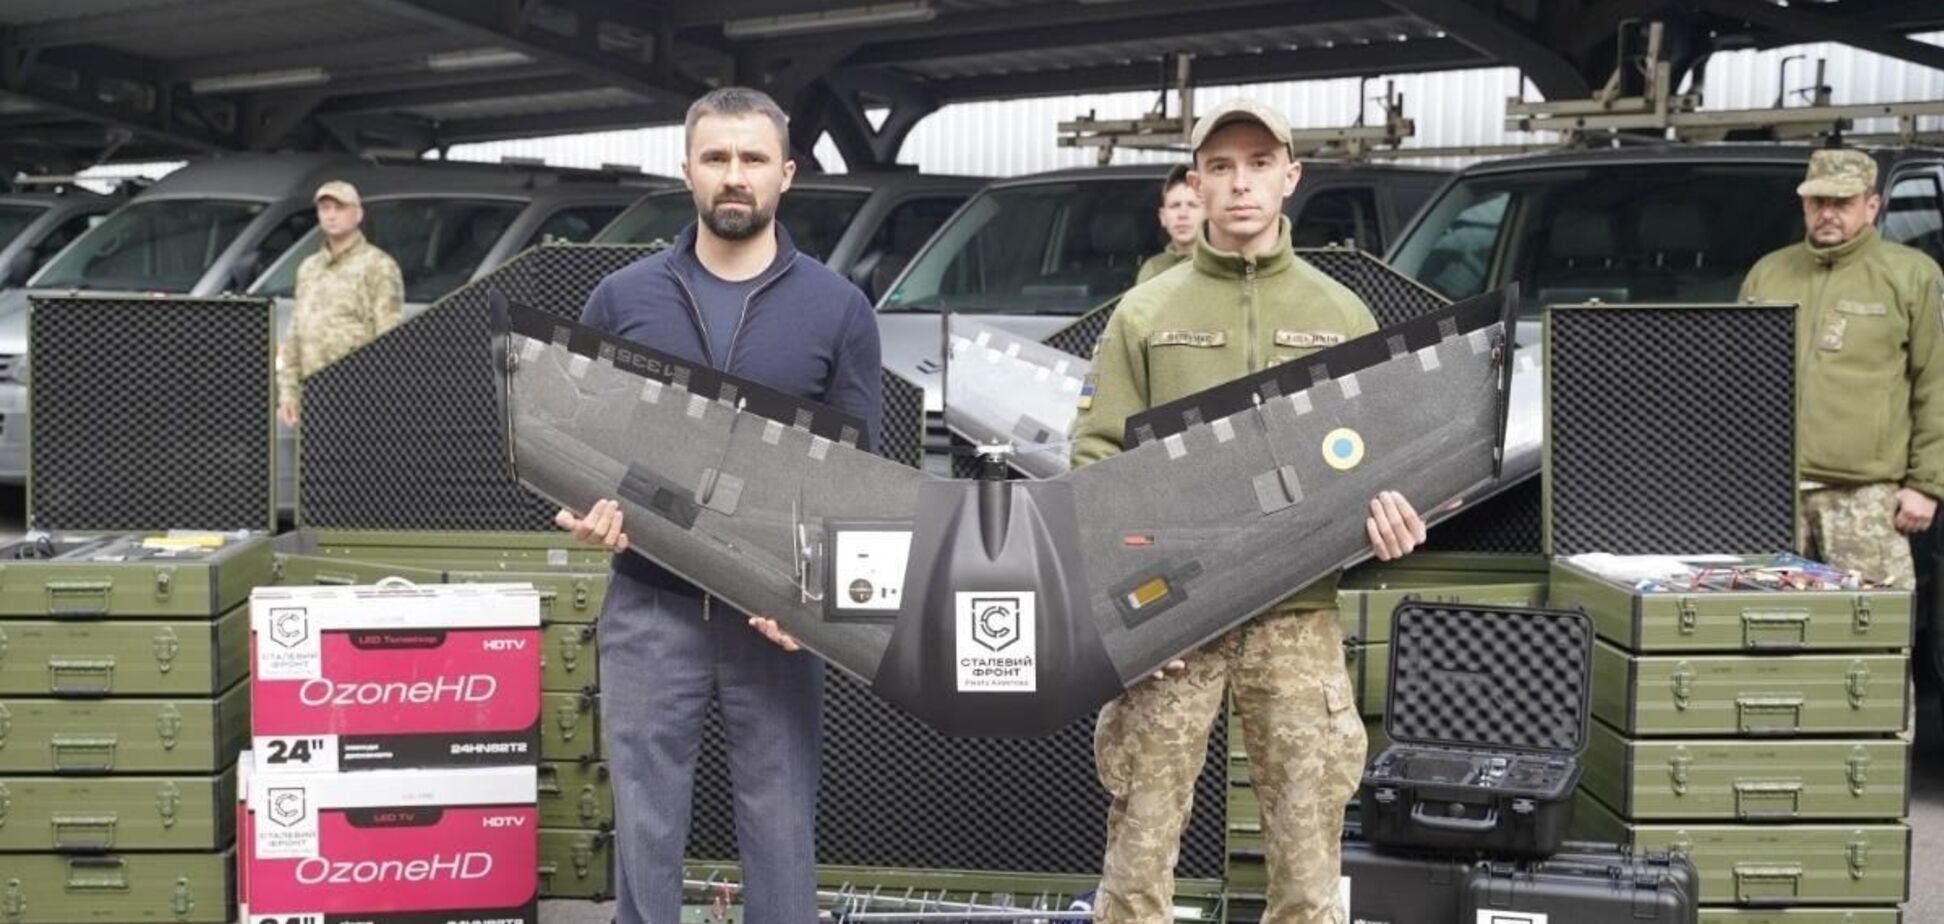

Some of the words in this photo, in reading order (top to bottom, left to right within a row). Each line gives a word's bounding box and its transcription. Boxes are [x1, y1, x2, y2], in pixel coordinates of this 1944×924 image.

[483, 639, 526, 650] HDTV
[960, 655, 1032, 667] СТАЛЕВИЙ
[972, 668, 1020, 677] ФРОНТ
[299, 674, 497, 706] OzoneHD
[267, 739, 323, 764] 24"
[373, 813, 397, 822] LED
[398, 812, 415, 822] TV
[482, 816, 525, 827] HDTV
[295, 852, 493, 884] OzoneHD
